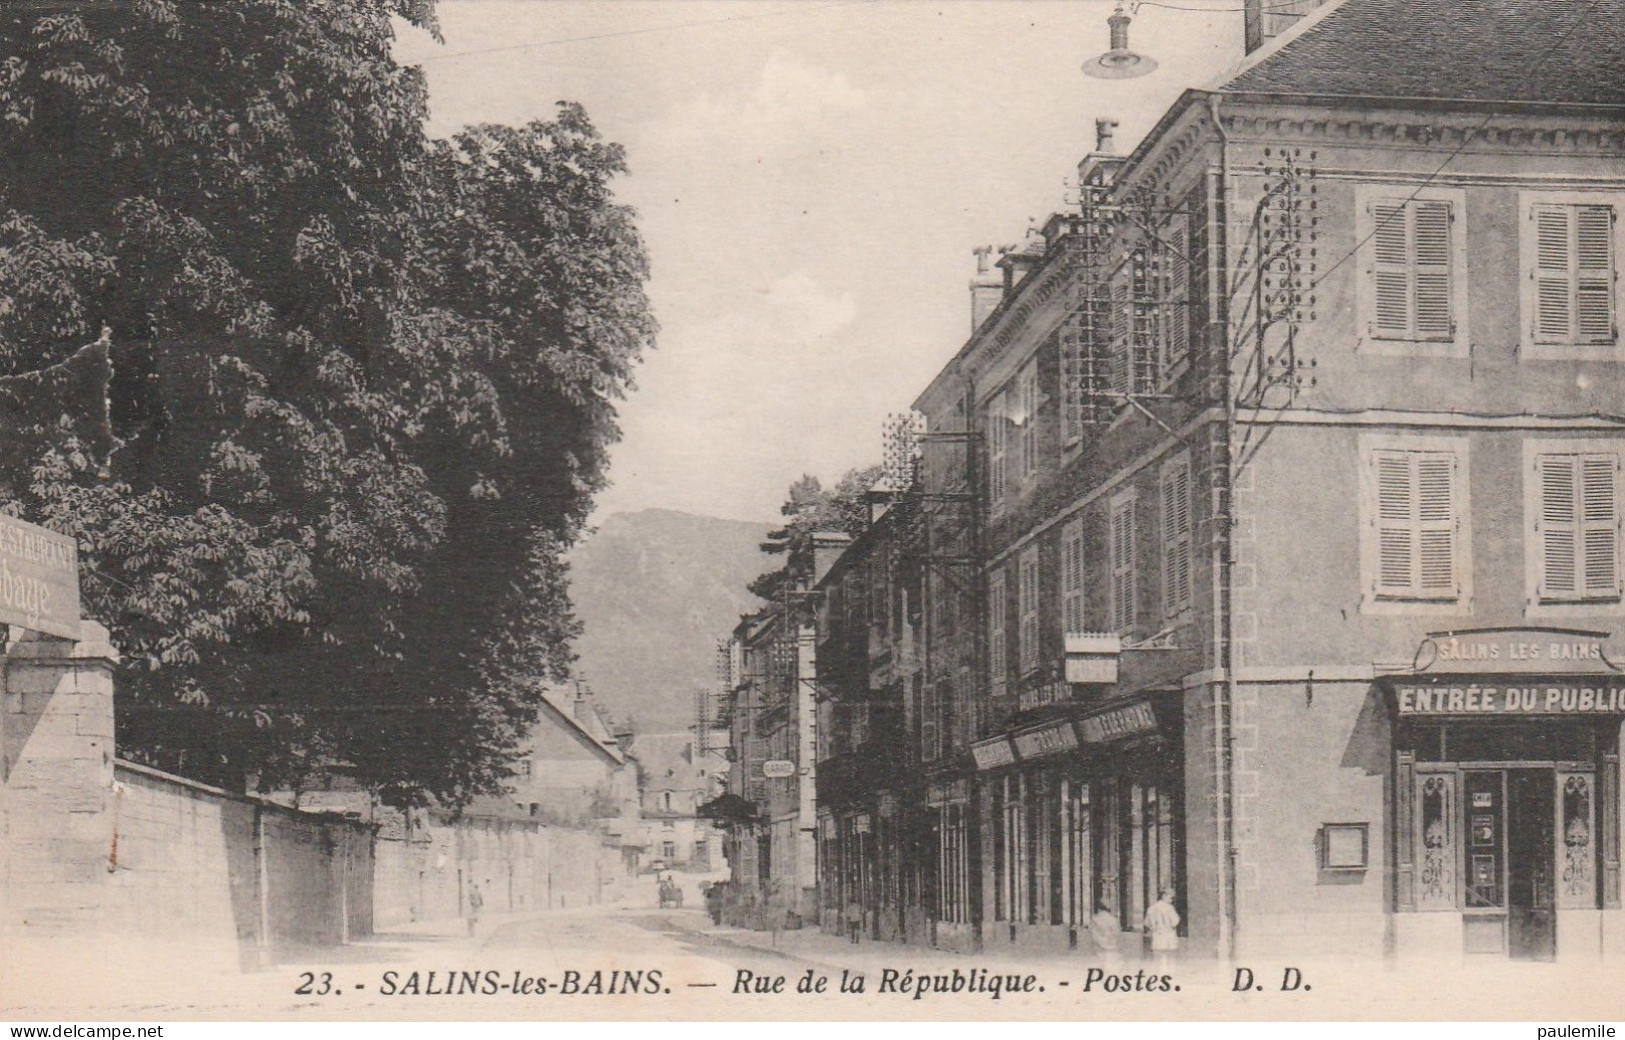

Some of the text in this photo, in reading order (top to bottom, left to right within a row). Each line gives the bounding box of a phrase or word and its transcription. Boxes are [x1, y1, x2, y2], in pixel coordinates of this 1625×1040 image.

[0, 558, 51, 625] bage
[1438, 643, 1601, 661] SALINS LES BAINS
[1398, 683, 1497, 713] ENTRÉE
[1504, 687, 1538, 713] DU
